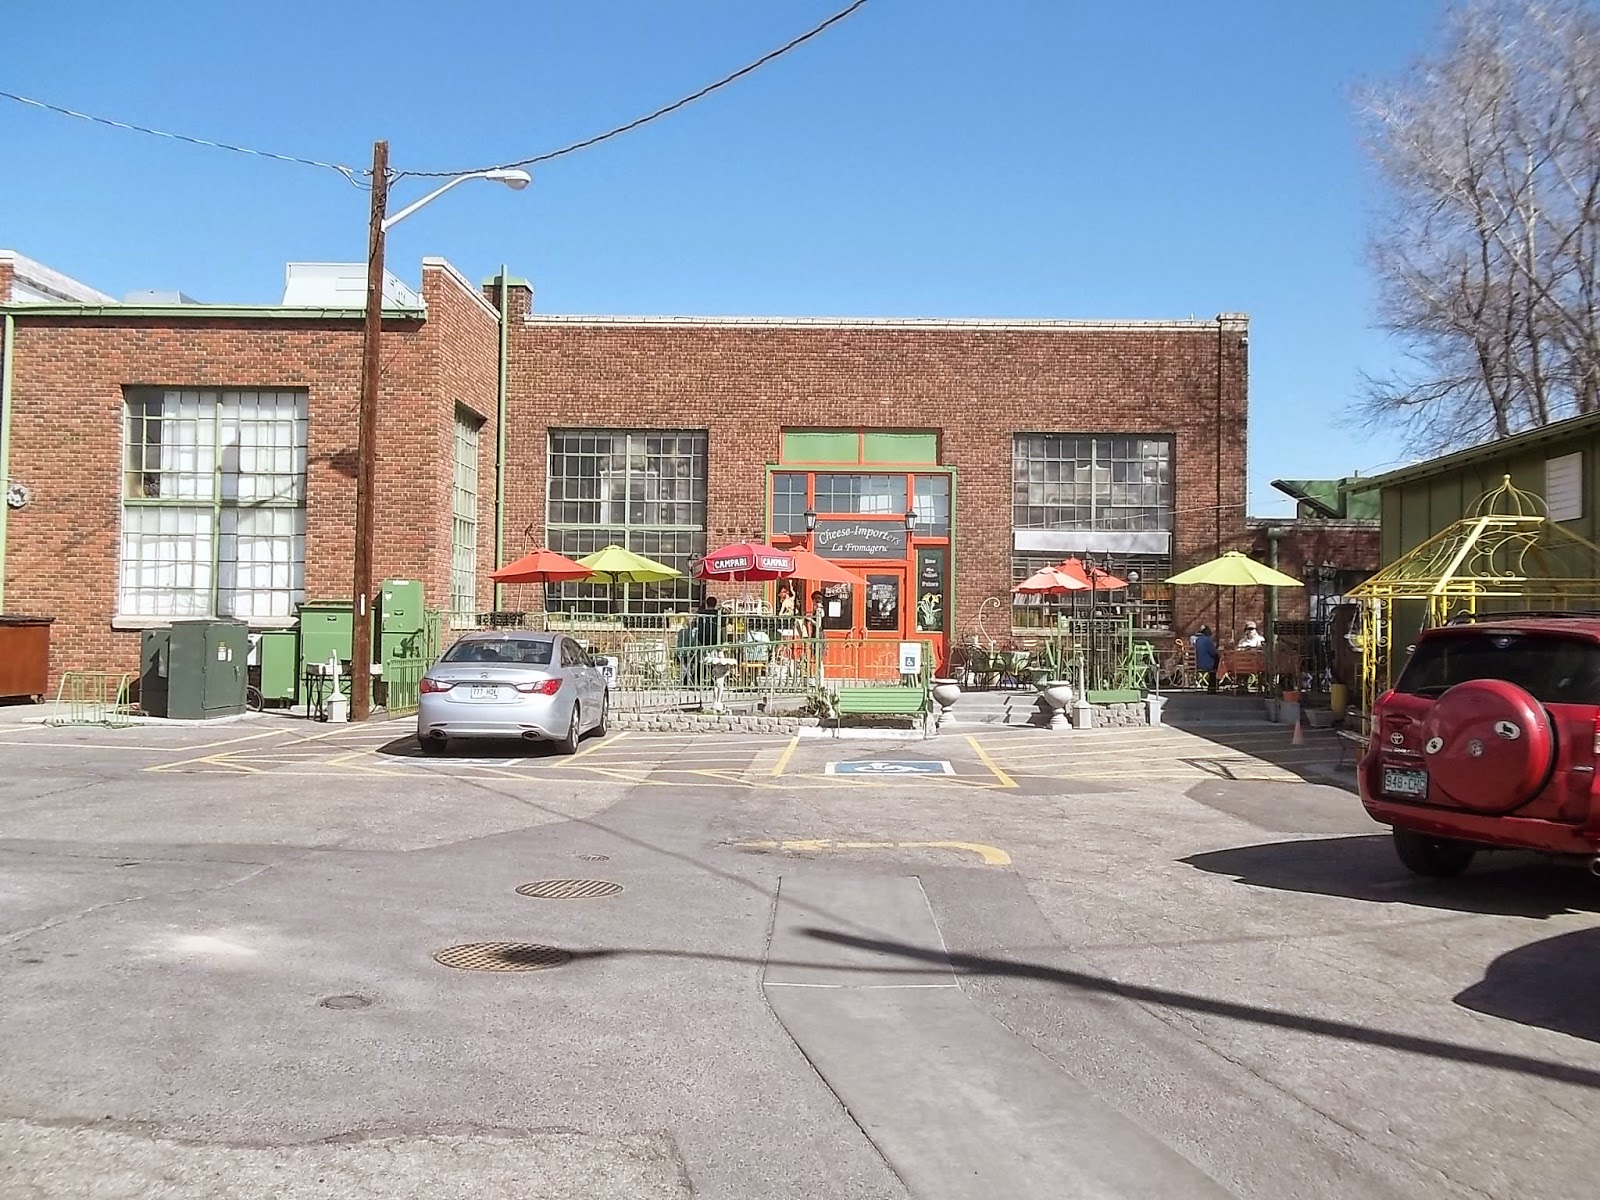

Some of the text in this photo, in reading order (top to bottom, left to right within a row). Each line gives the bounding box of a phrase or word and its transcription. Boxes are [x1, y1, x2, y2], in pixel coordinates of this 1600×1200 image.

[818, 525, 901, 546] Cheese Importers
[831, 543, 843, 552] La
[714, 557, 748, 570] CAMPARI
[762, 557, 789, 568] CAMPARI
